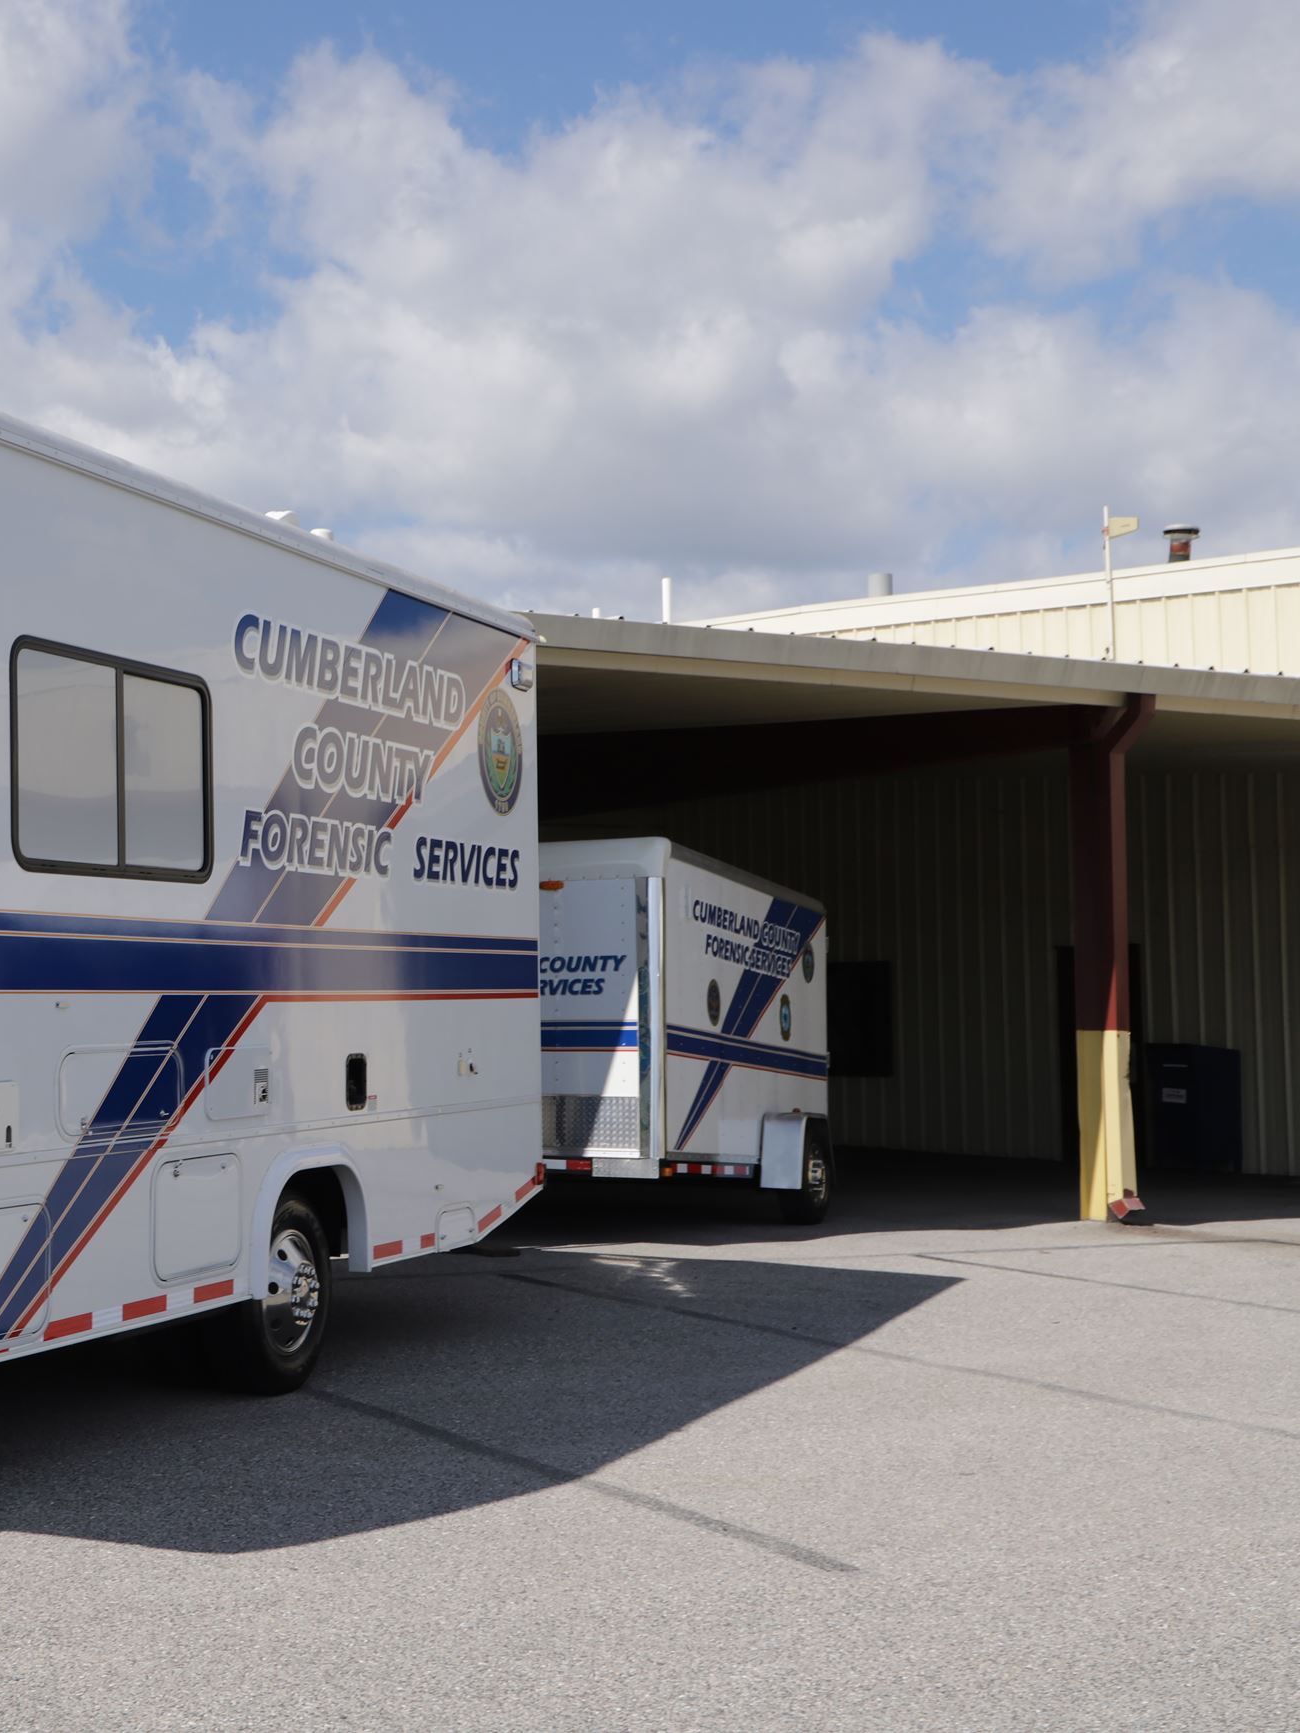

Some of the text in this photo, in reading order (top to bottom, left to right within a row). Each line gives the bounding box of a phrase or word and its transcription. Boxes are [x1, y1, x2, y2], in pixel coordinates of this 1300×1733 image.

[234, 613, 466, 729] CUMBERLAND
[293, 723, 434, 805] COUNTY
[239, 809, 520, 889] FORENSIC SERVICES
[693, 899, 801, 955] CUMBERLAND COUNTY
[705, 934, 792, 979] FORENSIC SERVICES
[540, 955, 627, 973] COUNTY
